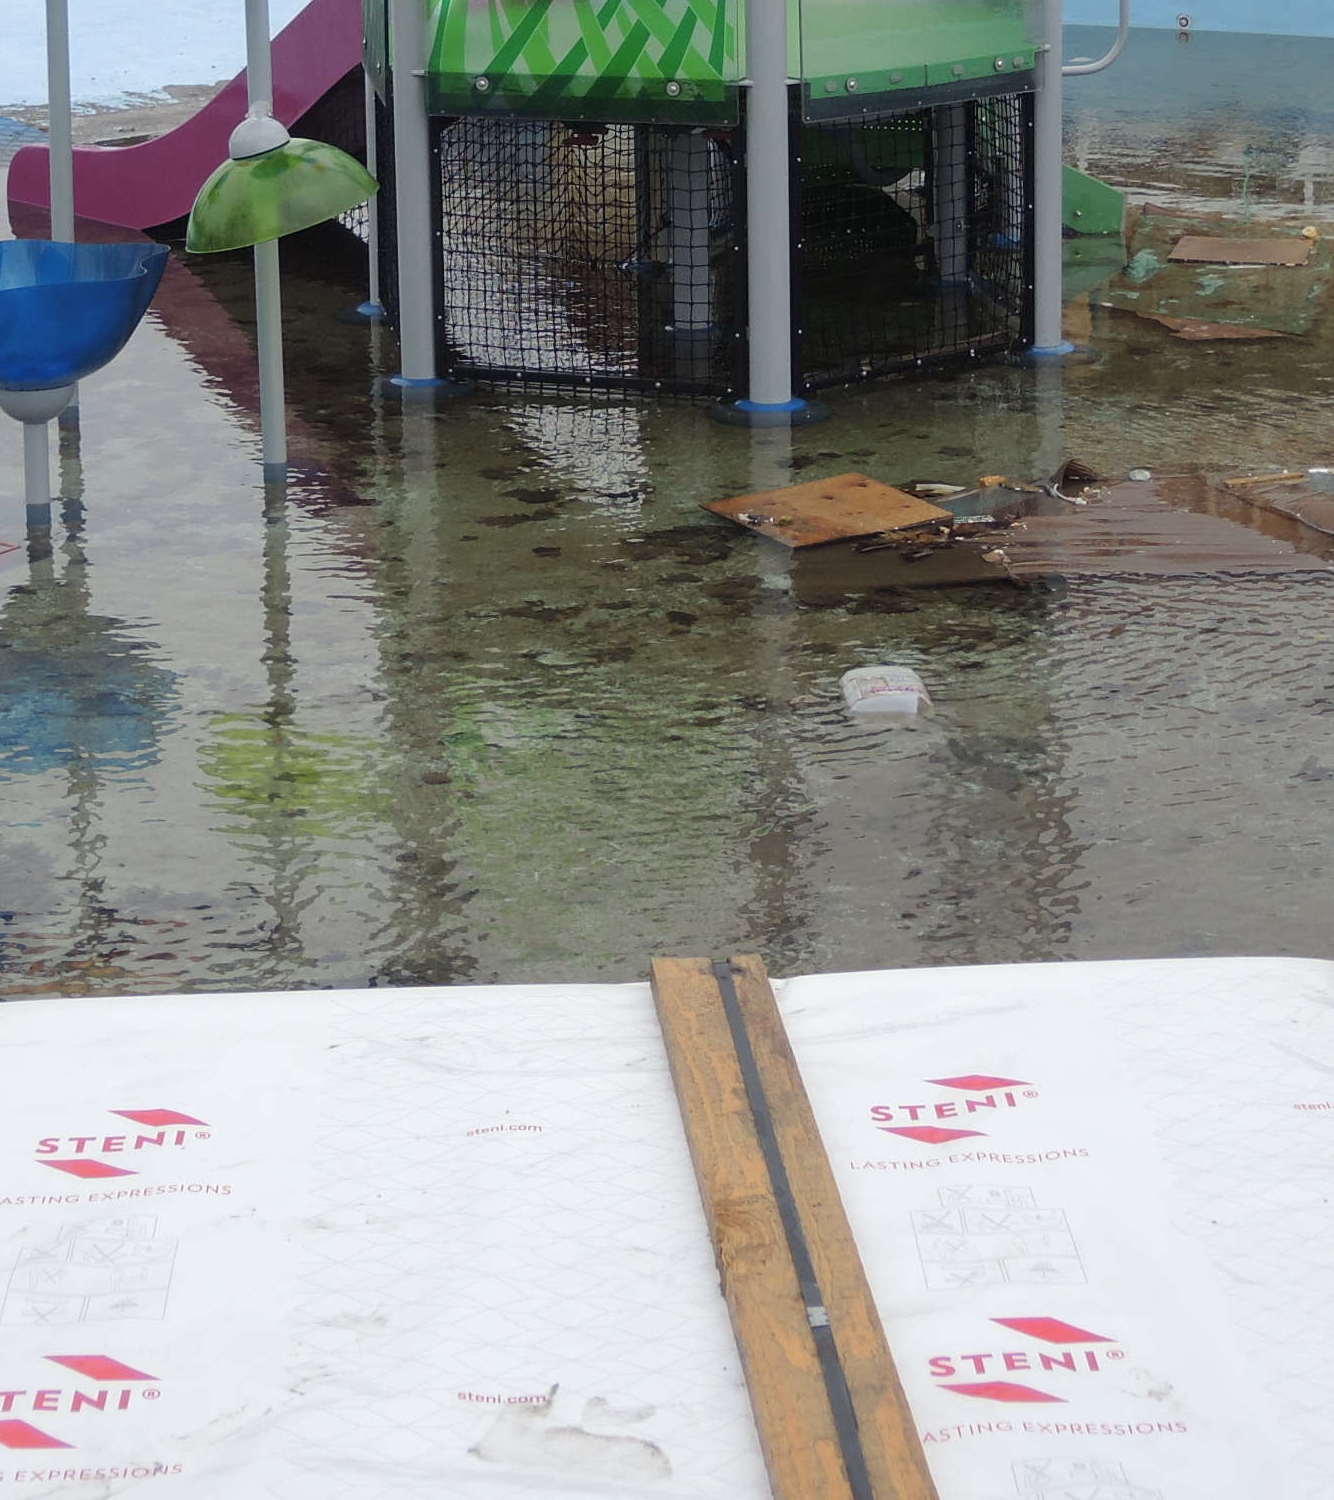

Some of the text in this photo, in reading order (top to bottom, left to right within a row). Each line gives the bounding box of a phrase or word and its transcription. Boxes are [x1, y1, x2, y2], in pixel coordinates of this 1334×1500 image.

[466, 1123, 543, 1137] steni.com
[850, 1148, 1089, 1171] LASTING EXPRESSIONS
[87, 1184, 233, 1202] EXPRESSIONS
[457, 1391, 548, 1405] steni.com
[922, 1421, 1189, 1444] ASTING EXPRESSIONS
[14, 1464, 184, 1483] EXPRESSIONS
